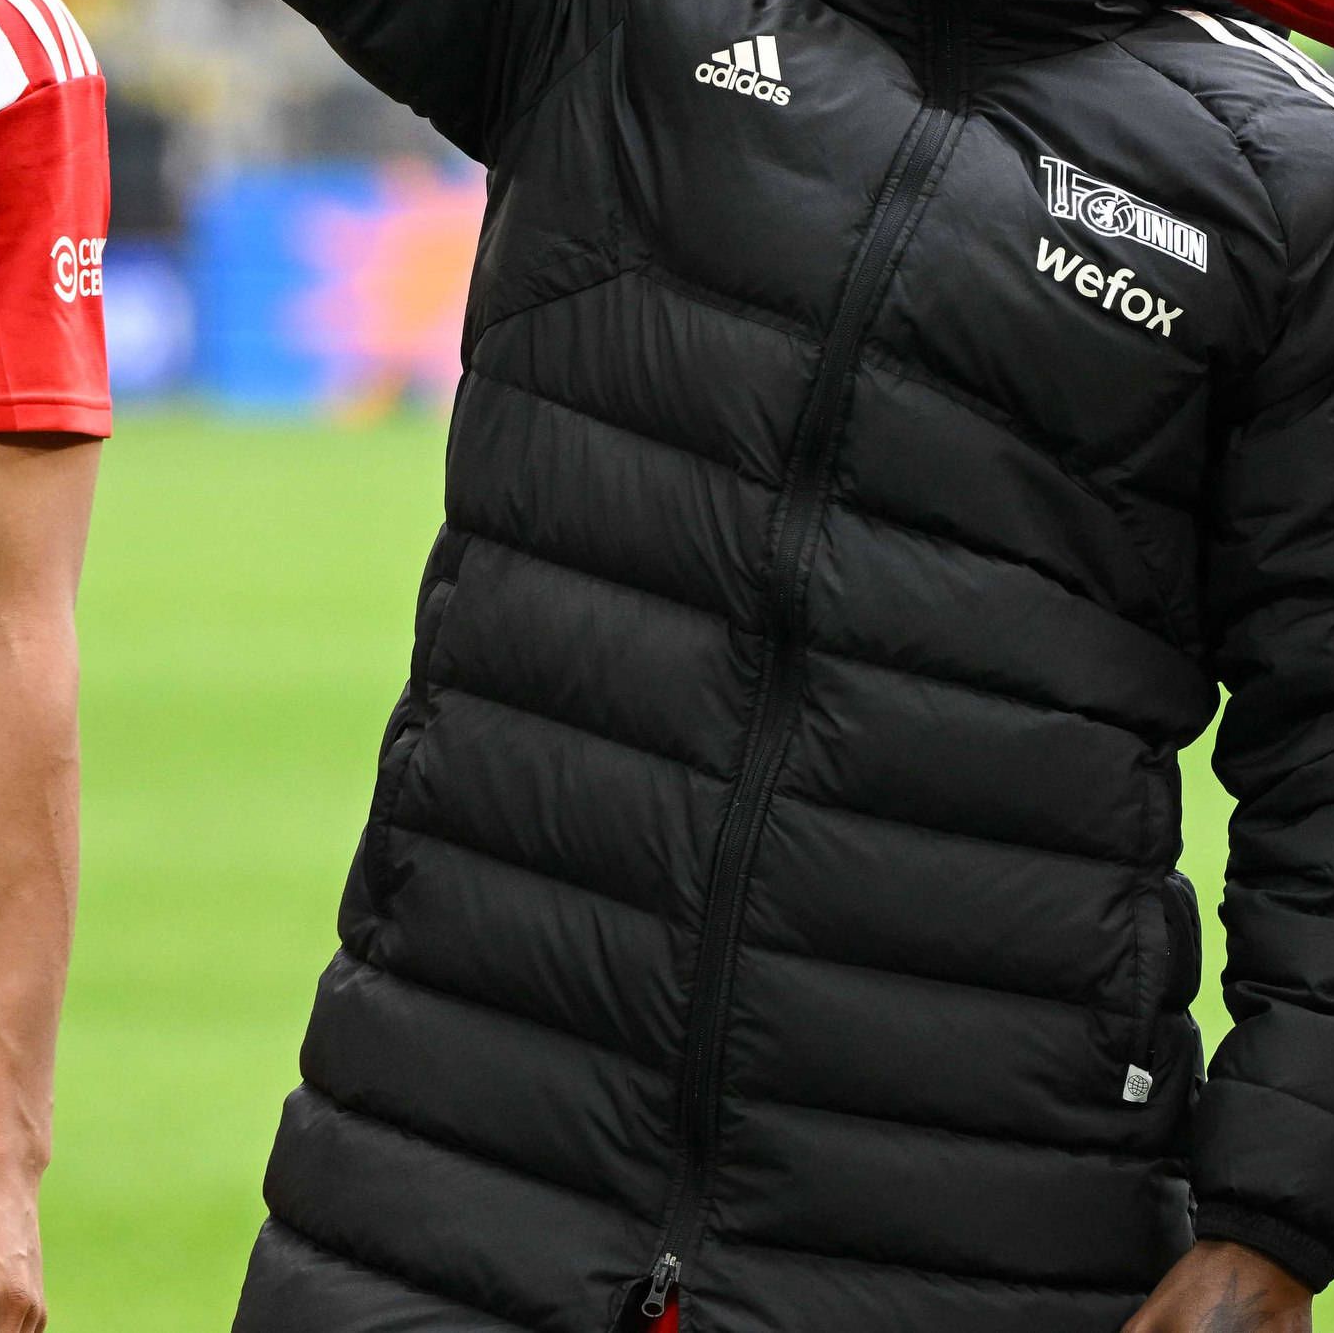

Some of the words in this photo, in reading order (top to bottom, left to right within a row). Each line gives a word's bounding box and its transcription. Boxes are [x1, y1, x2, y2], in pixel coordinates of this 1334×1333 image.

[694, 62, 791, 106] adidas
[1135, 208, 1205, 267] UNION
[1036, 236, 1184, 338] wefox
